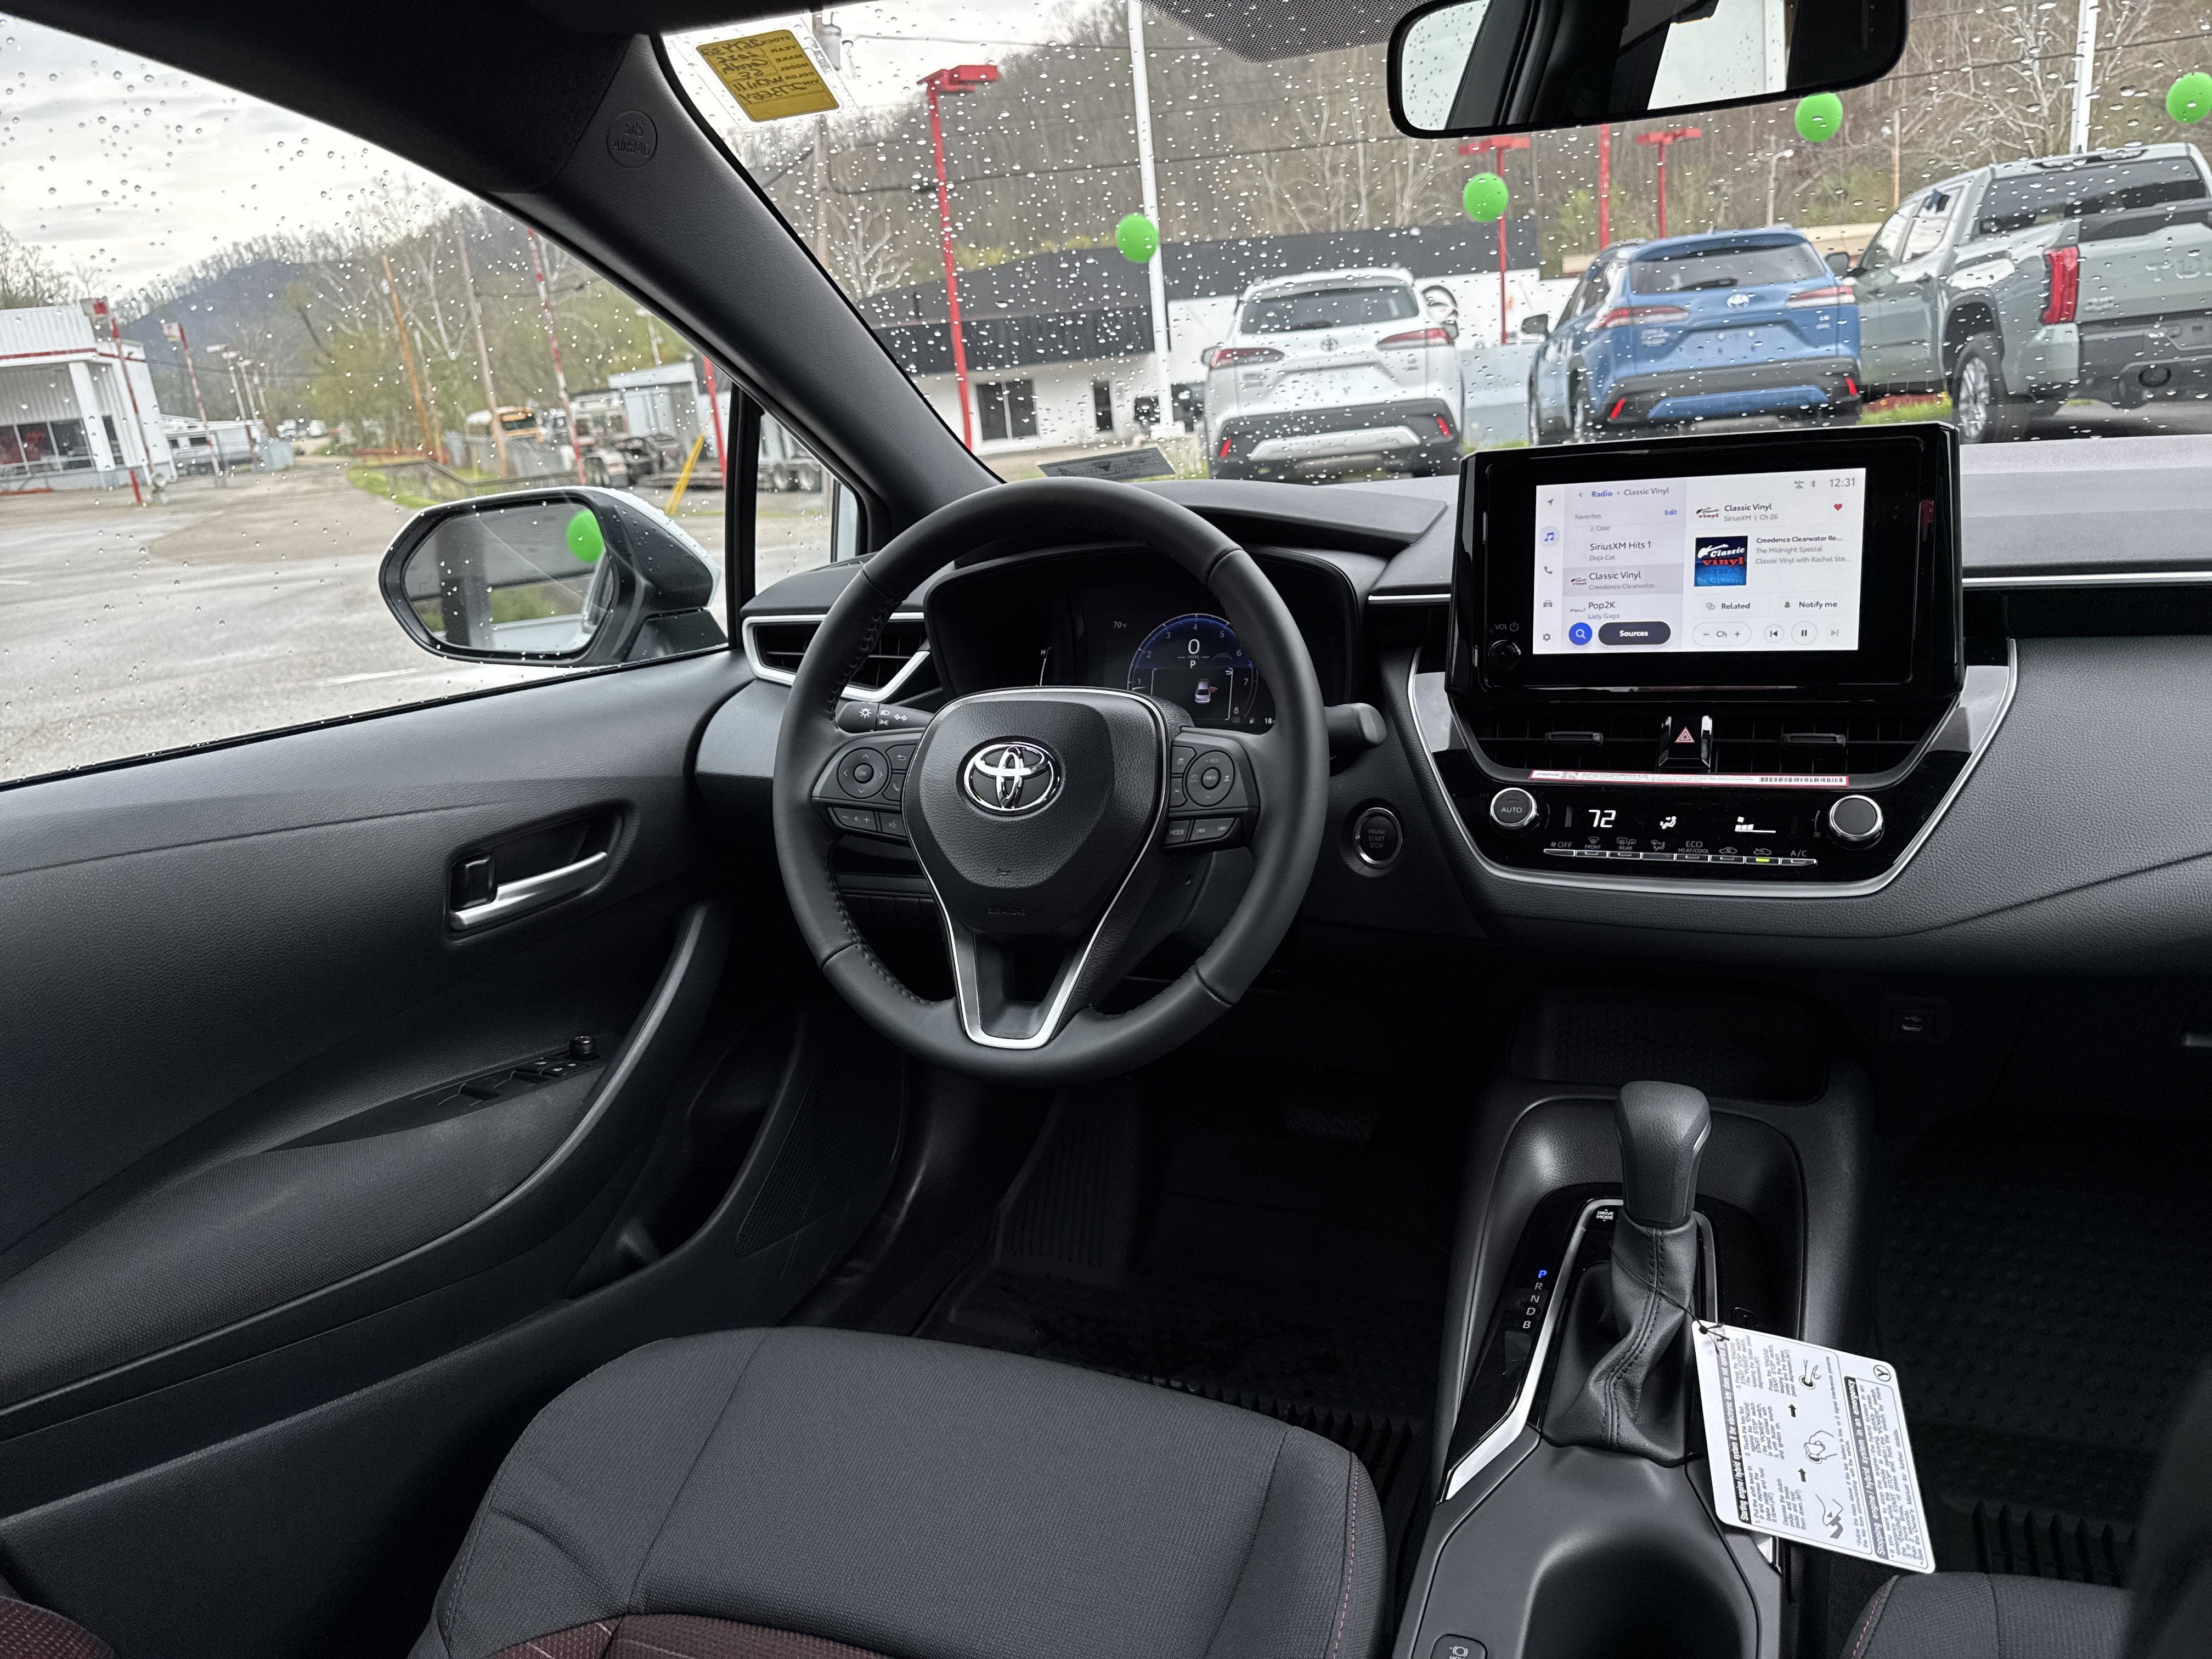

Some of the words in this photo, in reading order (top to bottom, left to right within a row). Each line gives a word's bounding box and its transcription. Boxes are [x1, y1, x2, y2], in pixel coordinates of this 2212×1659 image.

[1830, 478, 1855, 488] 12:31
[1650, 487, 1670, 496] Vinyl
[1753, 503, 1772, 513] Vinyl
[1590, 542, 1626, 551] SiriusXM
[1628, 541, 1645, 549] Hits
[1647, 540, 1651, 549] 1
[1769, 546, 1798, 555] Midnight
[1799, 546, 1822, 554] Special
[1710, 546, 1745, 558] Classic
[1702, 556, 1744, 567] vinyl
[1779, 557, 1795, 565] Vinyl
[1589, 572, 1619, 580] Classic
[1620, 571, 1642, 580] Vinyl
[1588, 601, 1616, 611] Pop2K
[1721, 602, 1751, 610] Related
[1798, 601, 1823, 610] Notify
[1188, 639, 1200, 654] 0
[1190, 660, 1196, 669] P
[1588, 809, 1617, 828] 72
[1538, 1269, 1548, 1279] P
[1534, 1282, 1543, 1290] R
[1530, 1295, 1540, 1303] N
[1526, 1307, 1536, 1316] D
[1522, 1321, 1531, 1329] B
[1720, 1366, 1729, 1376] not
[1875, 1367, 1889, 1379] Y
[1721, 1376, 1730, 1389] does
[1723, 1390, 1734, 1400] key
[1847, 1379, 1861, 1416] emergency
[1724, 1400, 1735, 1425] electronic
[1854, 1417, 1862, 1427] an
[1728, 1425, 1737, 1435] the
[1855, 1428, 1864, 1436] in
[1731, 1441, 1742, 1460] system
[1857, 1438, 1870, 1465] system
[1737, 1499, 1750, 1521] Starting
[1871, 1521, 1887, 1556] Stopping
